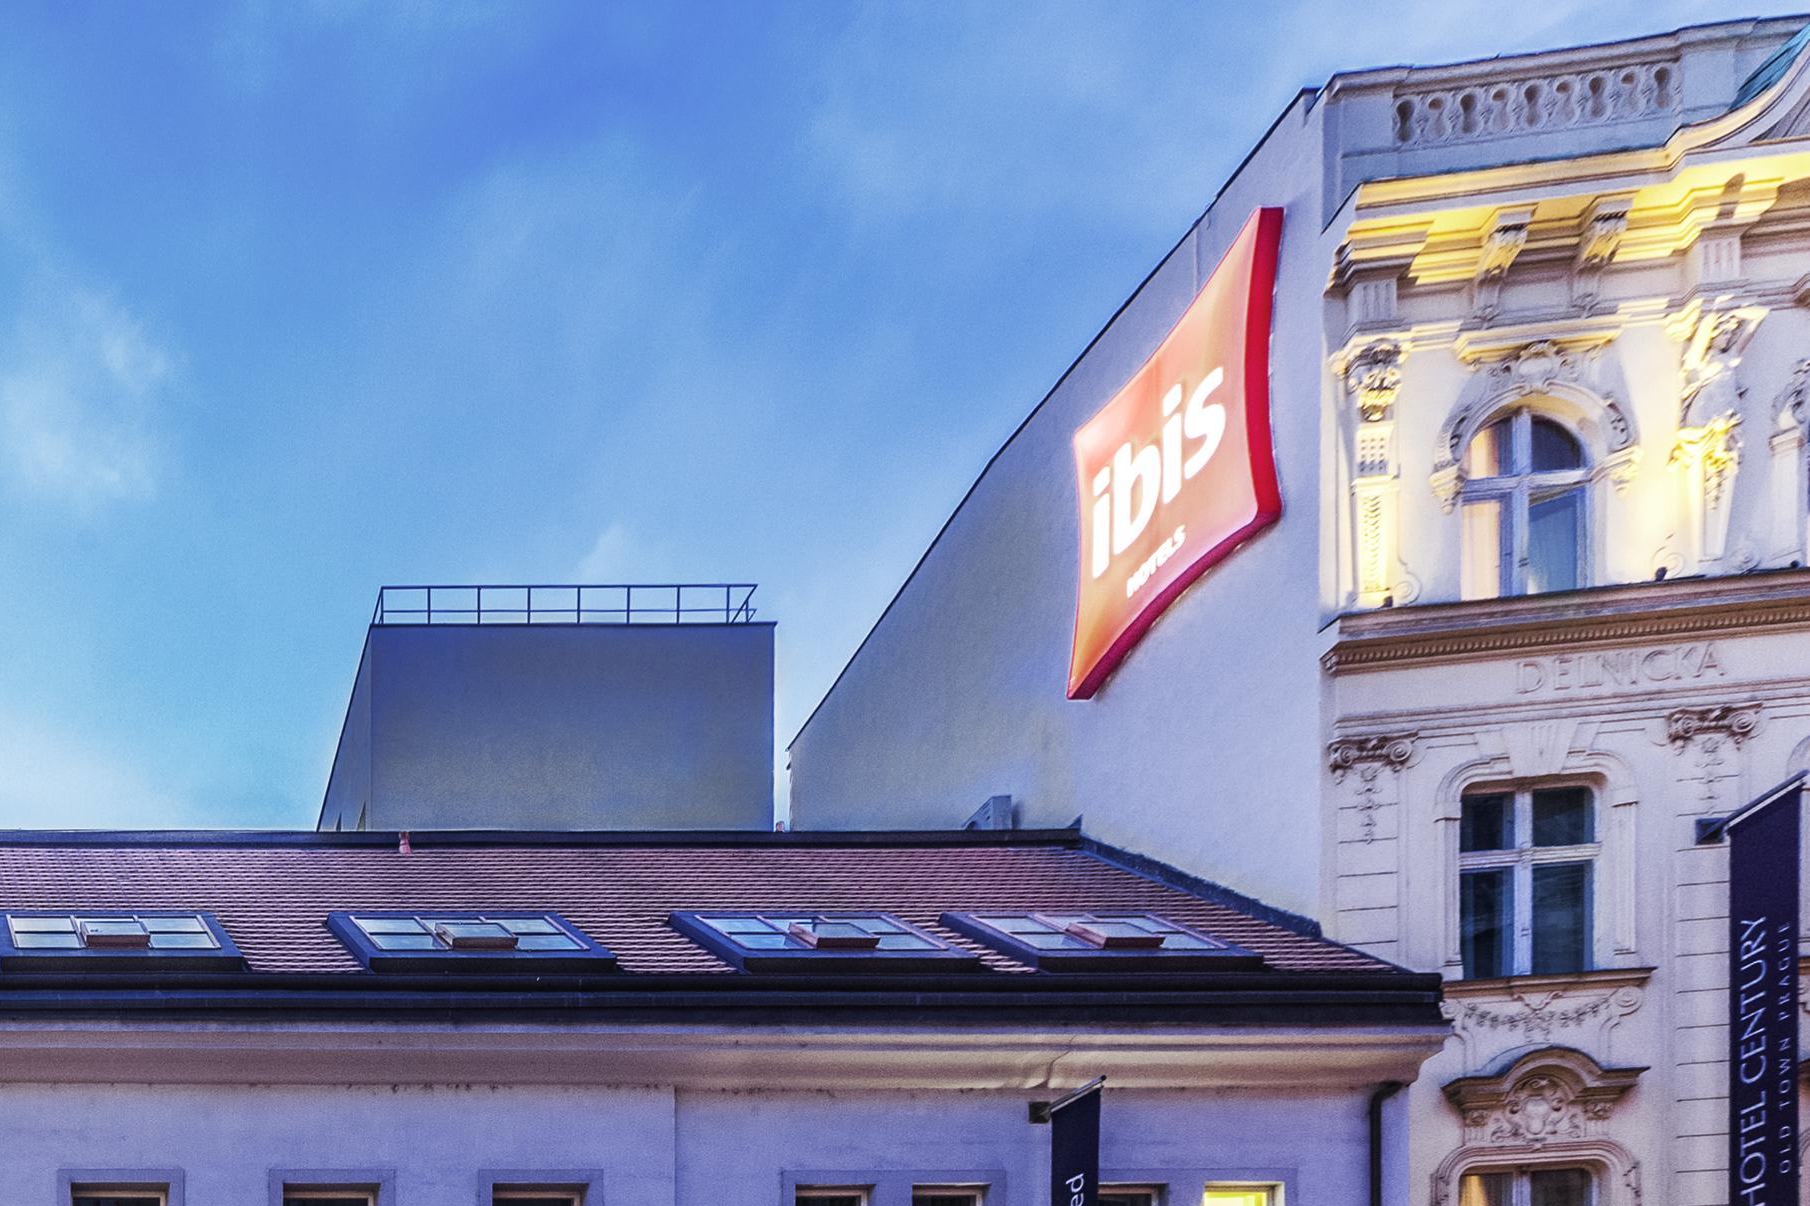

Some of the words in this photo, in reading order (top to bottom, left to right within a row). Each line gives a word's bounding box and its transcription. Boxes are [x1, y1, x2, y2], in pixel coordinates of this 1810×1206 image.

[1092, 367, 1226, 579] ibis
[1126, 525, 1186, 598] HOTELS
[1741, 916, 1766, 1084] CENTURY
[1779, 1037, 1791, 1110] TOWN
